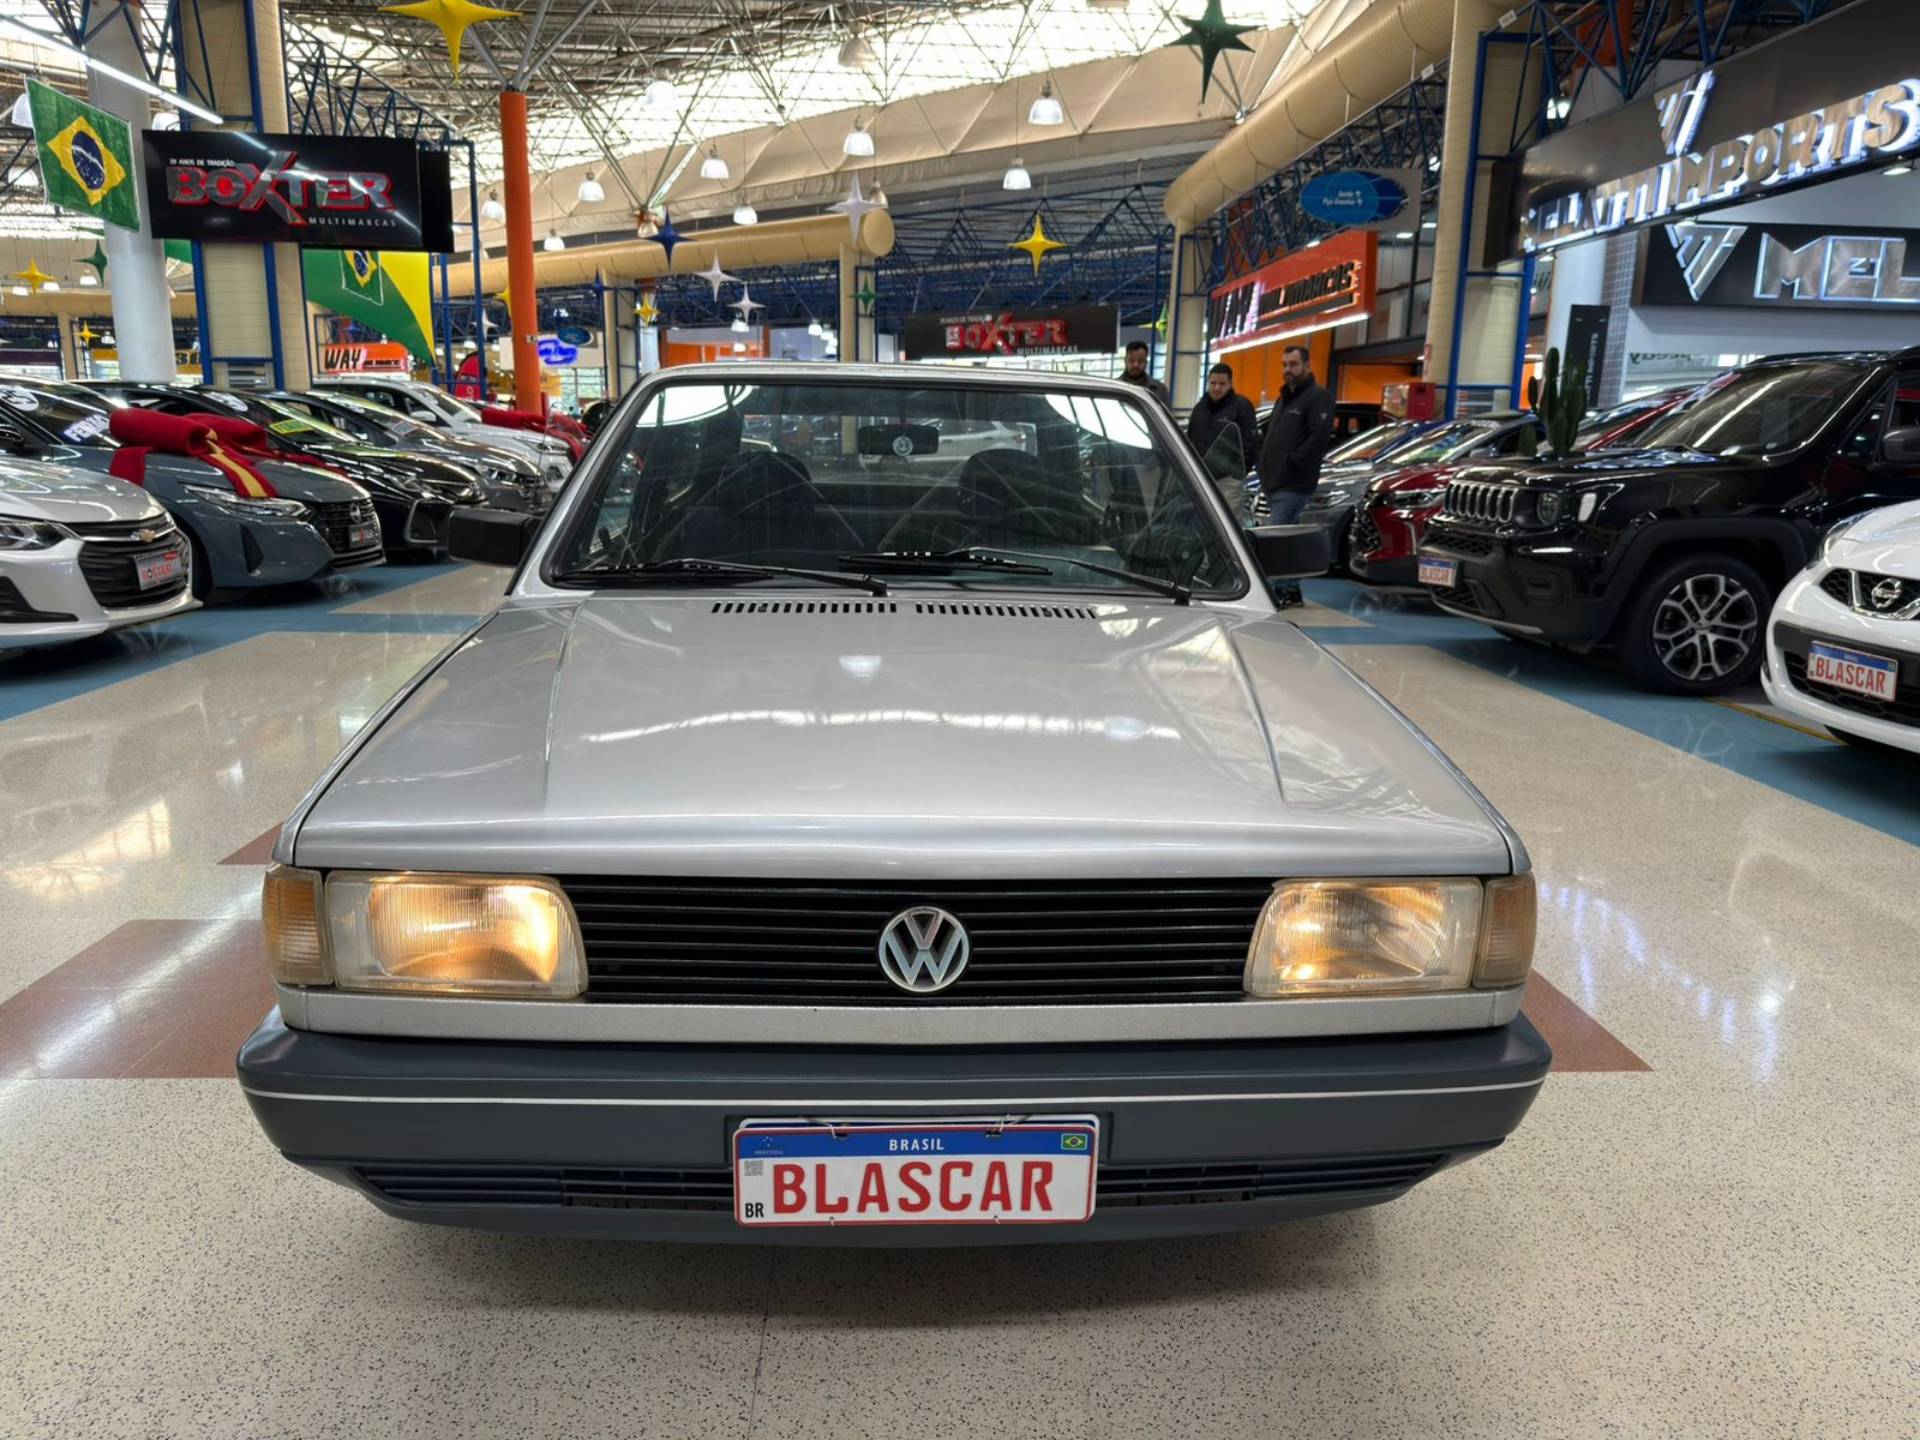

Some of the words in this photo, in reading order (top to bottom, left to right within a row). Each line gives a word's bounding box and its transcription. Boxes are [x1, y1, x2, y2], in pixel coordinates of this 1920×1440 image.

[1664, 82, 1919, 208] IMPORTS
[196, 159, 205, 167] DE
[166, 150, 397, 226] BOXTER
[308, 216, 397, 228] MULTIMARCAS
[945, 312, 1069, 356] BOXTER
[325, 347, 362, 370] WAY
[1016, 345, 1079, 356] MULTIMARCAS
[1815, 656, 1886, 693] BLASCAR
[888, 1138, 945, 1152] BRASIL
[772, 1160, 1054, 1215] BLASCAR
[744, 1202, 765, 1219] BR
